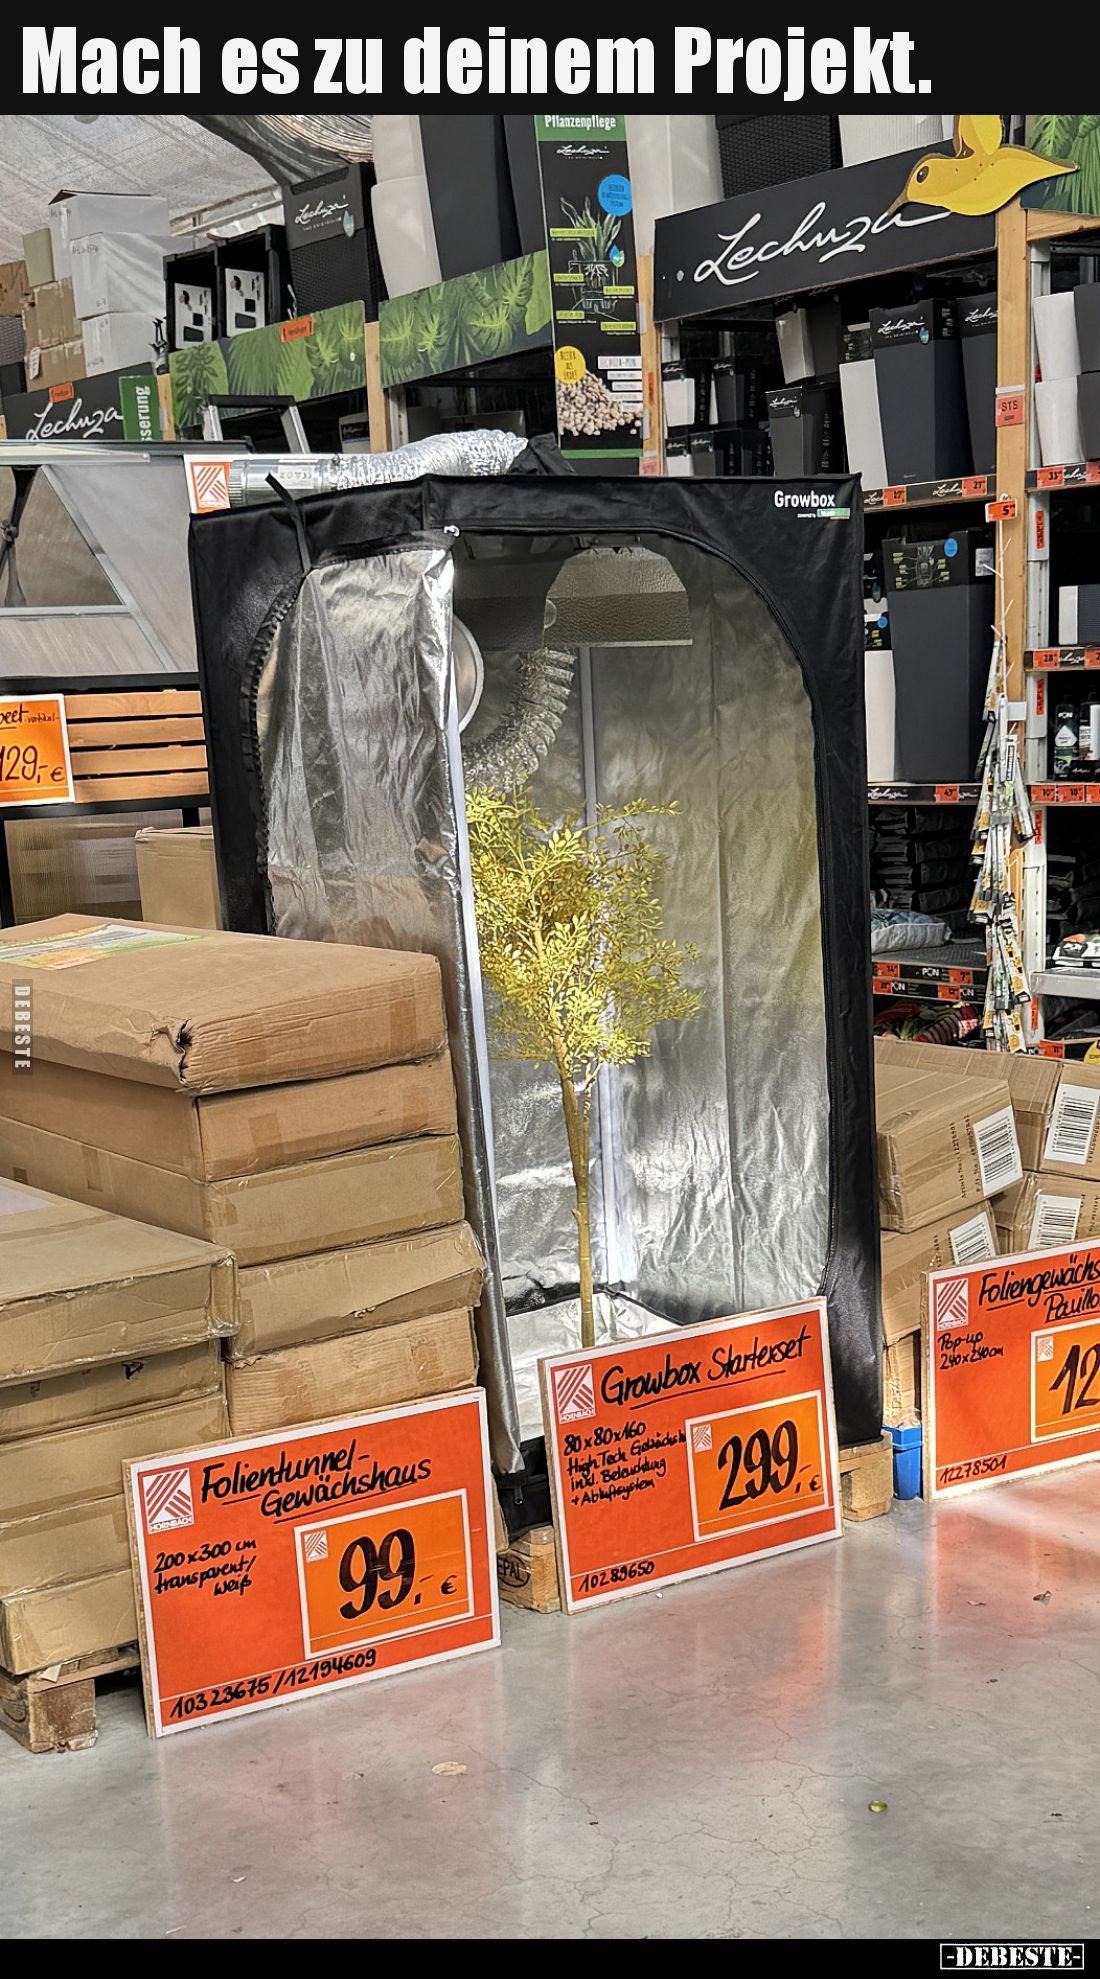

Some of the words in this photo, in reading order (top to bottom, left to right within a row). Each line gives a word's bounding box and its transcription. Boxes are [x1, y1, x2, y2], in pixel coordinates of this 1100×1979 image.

[544, 115, 617, 131] Pflanzenpflege
[693, 201, 951, 286] Lechuza
[774, 490, 836, 508] Growbox
[600, 1353, 702, 1406] Growbox
[707, 1325, 812, 1382] Starterset
[201, 1439, 370, 1503] Folientunnel-
[939, 1455, 1008, 1484] 12278501
[260, 1458, 432, 1518] Gewächshaus
[149, 1516, 193, 1532] HORNBACH
[213, 1573, 253, 1597] weiß
[440, 1575, 458, 1595] €
[578, 1560, 655, 1593] 10289650
